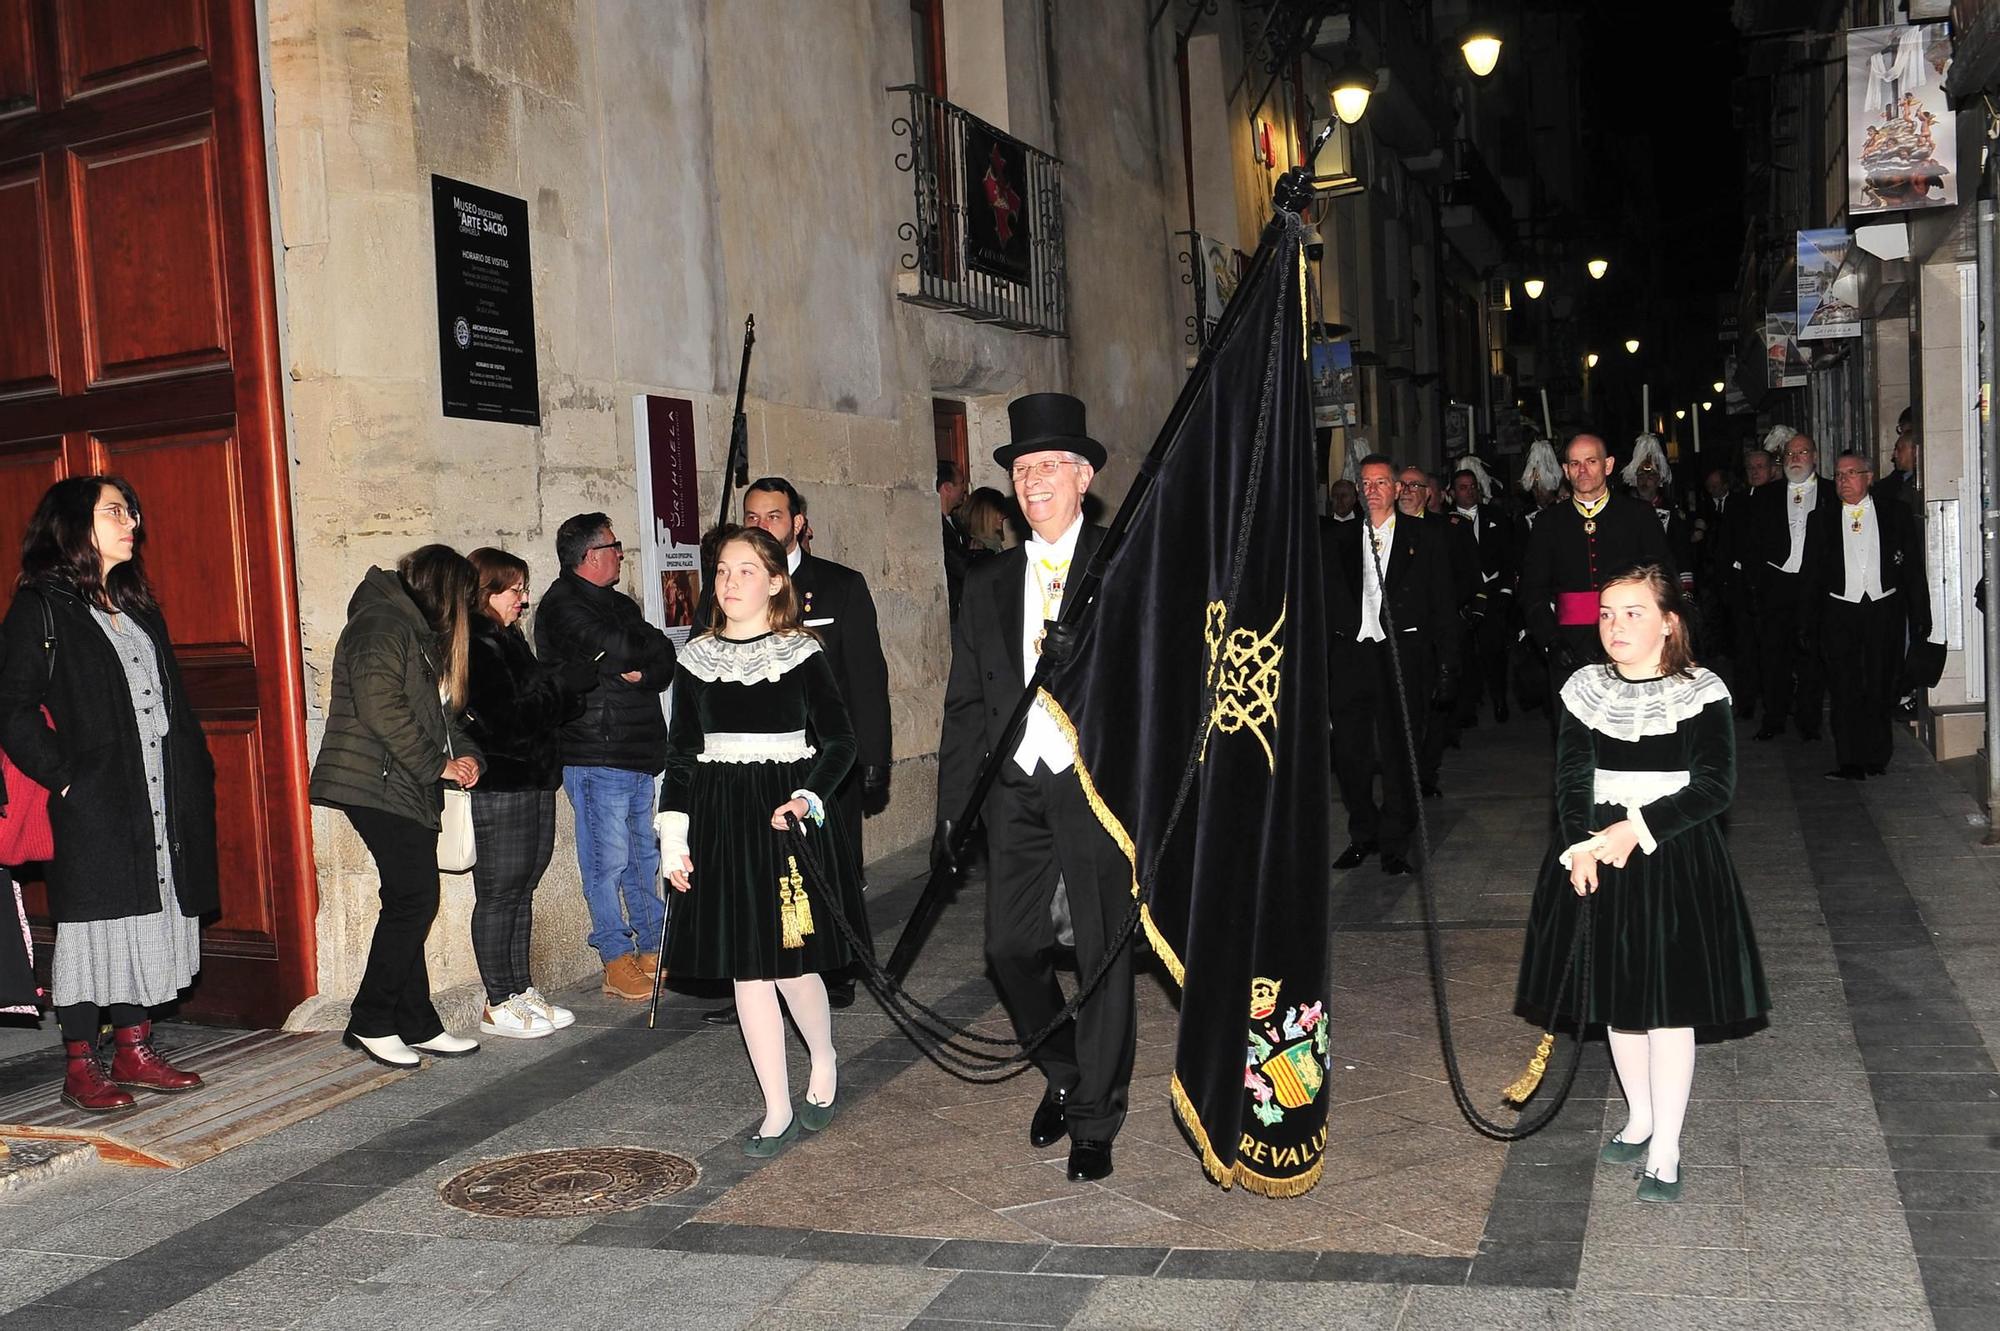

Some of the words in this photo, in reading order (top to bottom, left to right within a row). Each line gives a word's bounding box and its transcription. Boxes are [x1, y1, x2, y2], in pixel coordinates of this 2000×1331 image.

[453, 196, 477, 214] MUSEO
[461, 212, 482, 230] ARTE
[483, 218, 508, 237] SACRO
[462, 251, 484, 262] HORARIO
[484, 255, 492, 265] DE
[491, 257, 509, 268] VISITAS
